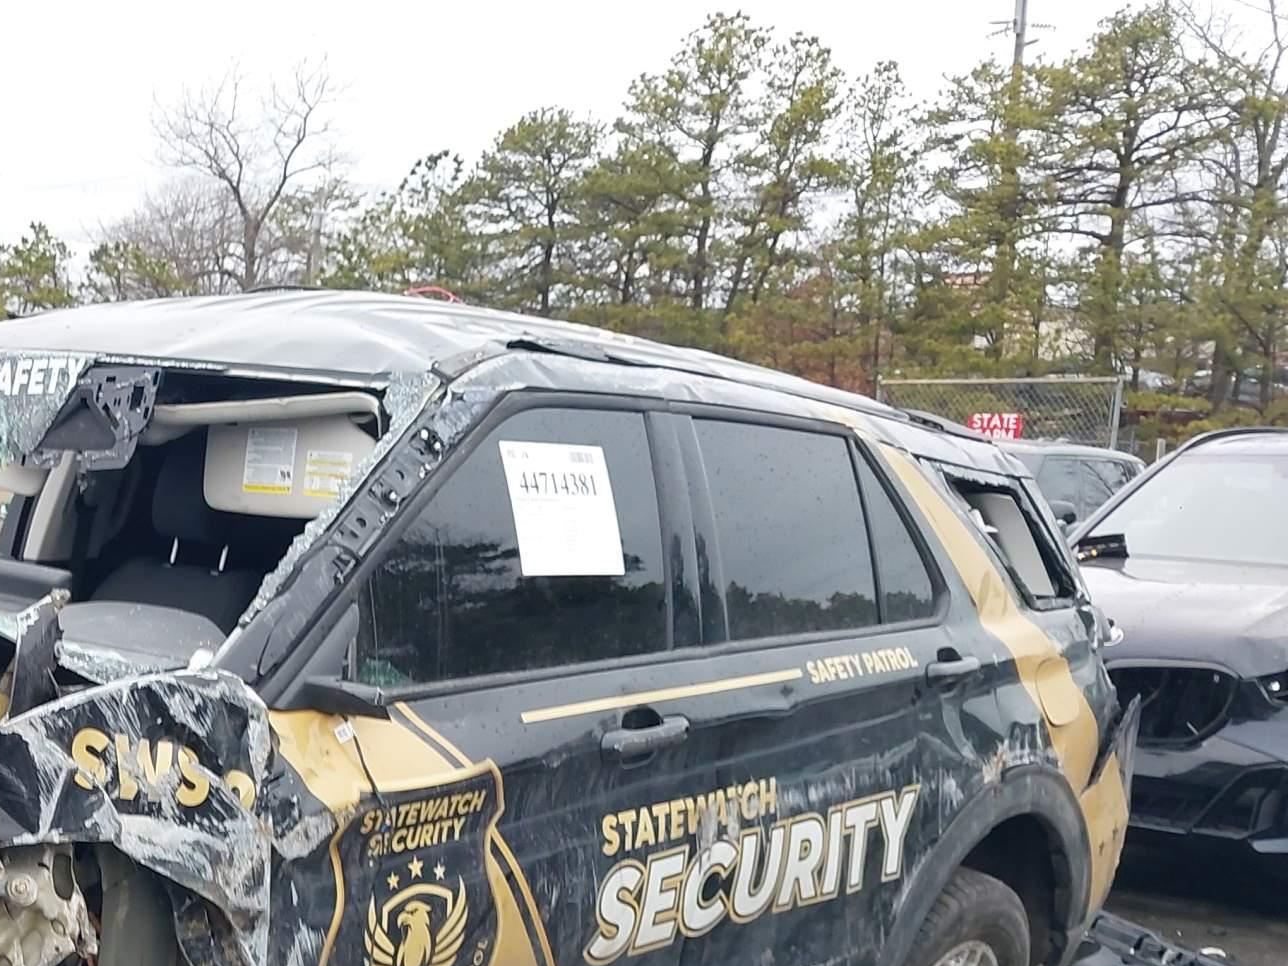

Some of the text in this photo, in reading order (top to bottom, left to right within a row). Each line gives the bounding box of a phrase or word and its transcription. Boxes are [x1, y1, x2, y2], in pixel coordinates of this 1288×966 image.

[972, 412, 1018, 430] STATE
[520, 472, 597, 496] 44714381
[806, 646, 919, 685] SAFETY PATROL
[601, 777, 777, 856] STATEWATCH
[583, 784, 921, 966] SECURITY
